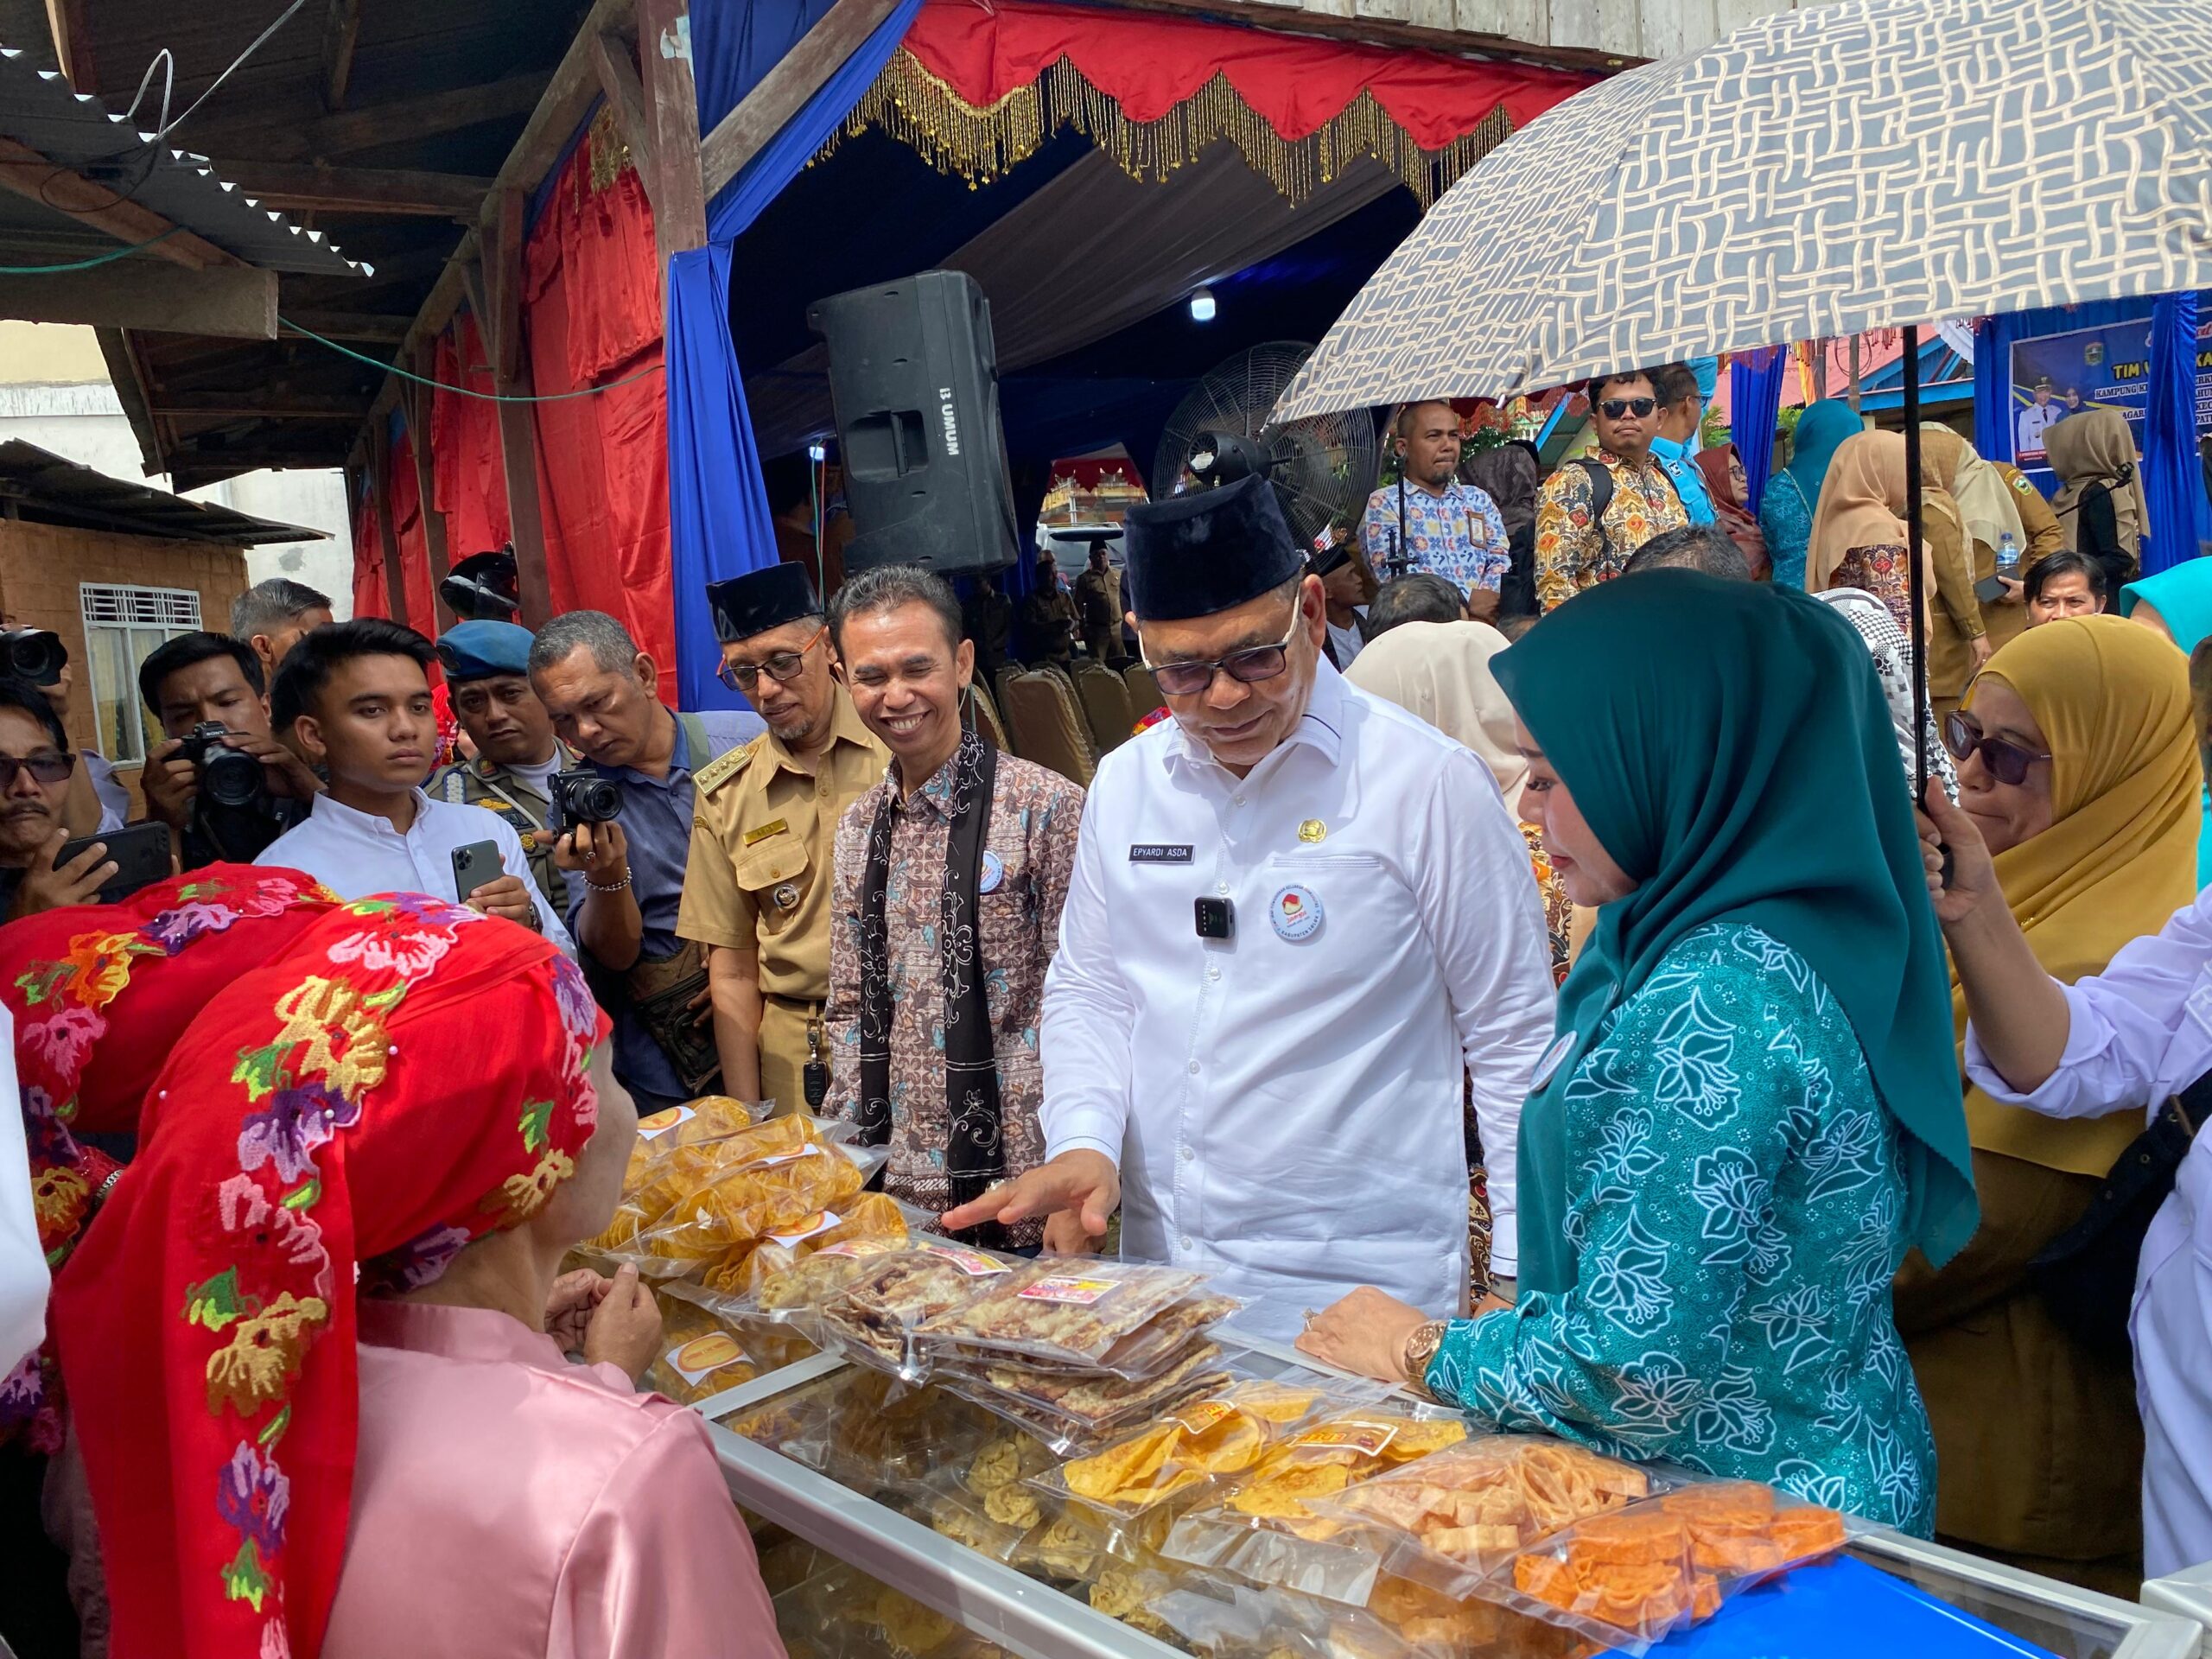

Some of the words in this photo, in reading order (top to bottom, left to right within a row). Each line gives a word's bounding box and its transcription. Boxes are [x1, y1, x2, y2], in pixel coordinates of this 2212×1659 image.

[2112, 362, 2140, 379] TIM
[2095, 385, 2137, 398] KAMPUNG
[942, 404, 959, 455] UMUM
[1133, 848, 1164, 856] EPYARDI
[1166, 848, 1187, 857] ASDA
